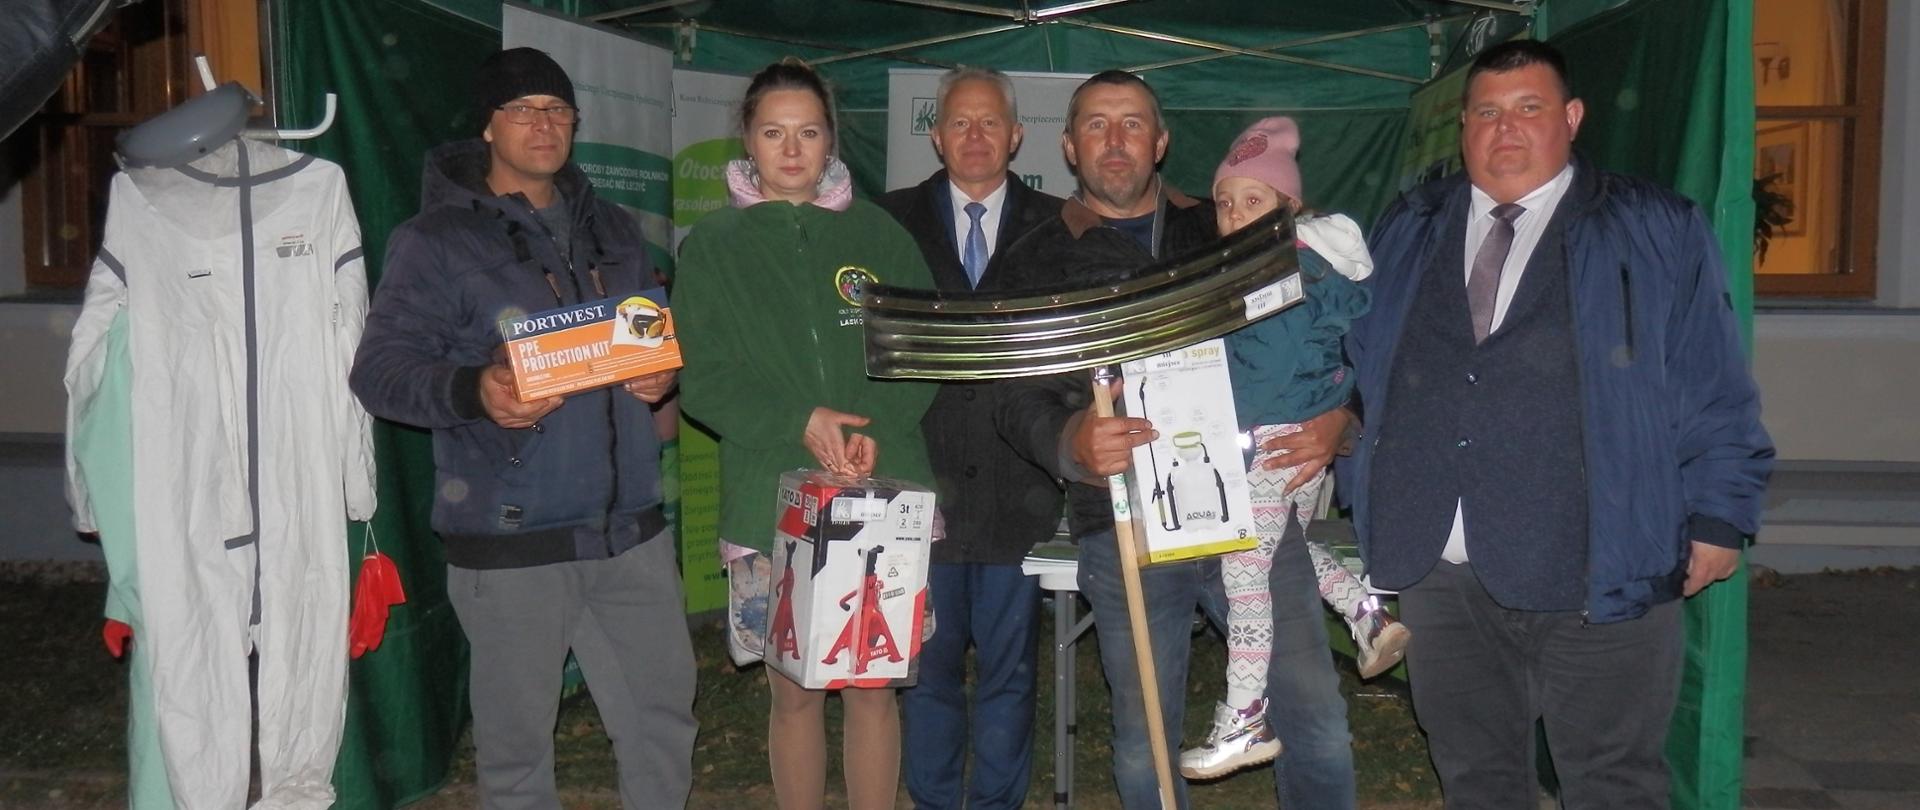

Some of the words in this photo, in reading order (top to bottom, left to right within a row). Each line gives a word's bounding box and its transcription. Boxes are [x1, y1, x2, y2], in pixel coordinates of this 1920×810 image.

[513, 305, 605, 335] PORTWEST
[518, 340, 540, 359] PPE
[521, 345, 591, 374] PROTECTION
[591, 340, 610, 359] KIT
[1192, 346, 1219, 360] spray
